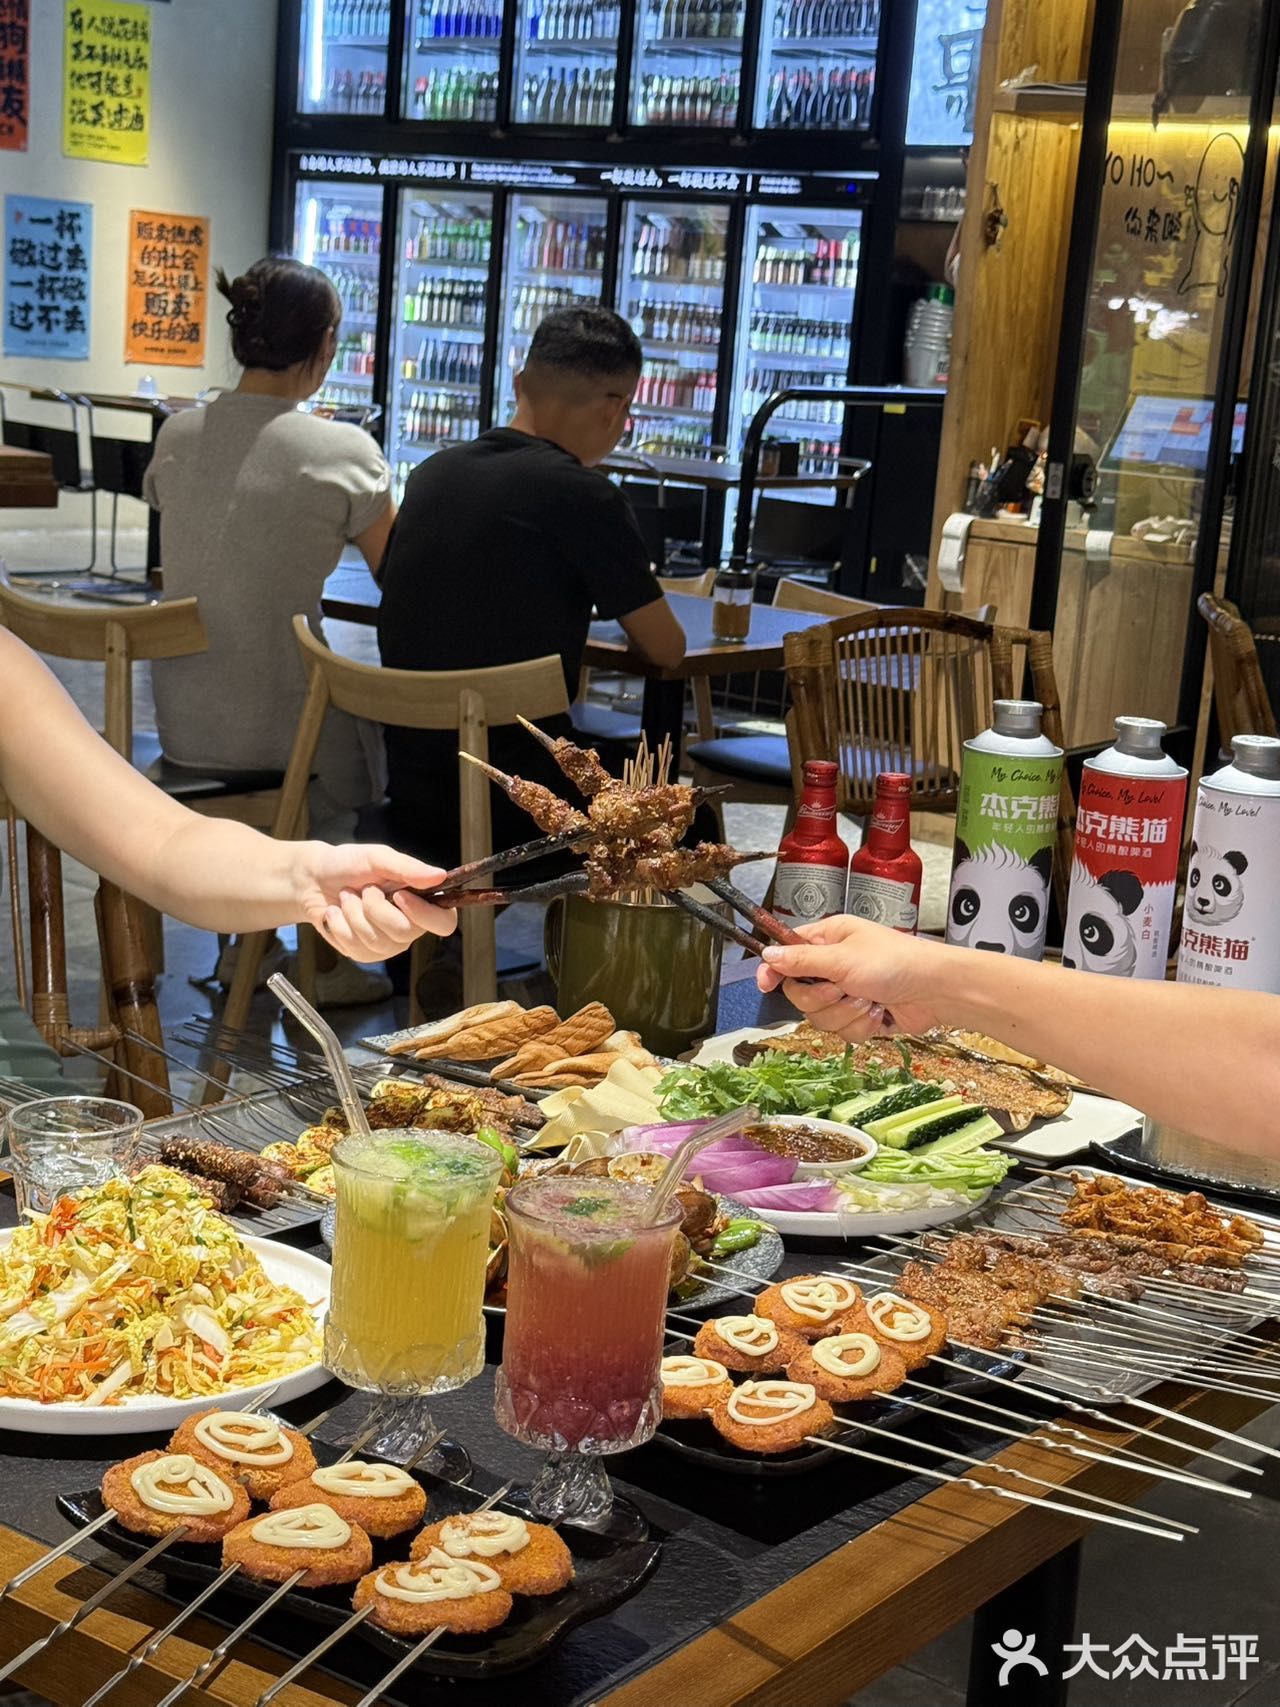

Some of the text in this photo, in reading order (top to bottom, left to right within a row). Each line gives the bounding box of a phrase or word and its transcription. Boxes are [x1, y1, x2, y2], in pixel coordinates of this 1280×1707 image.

[29, 210, 82, 241] 一杯
[137, 221, 204, 247] 贩卖焦虑
[10, 238, 87, 272] 敬过去
[141, 245, 198, 271] 的社会
[9, 273, 86, 303] 一杯敬
[9, 302, 86, 334] 过不去
[144, 292, 191, 321] 贩卖
[131, 319, 200, 343] 快乐的酒
[990, 766, 1006, 783] My
[1117, 788, 1135, 805] My
[1218, 801, 1232, 817] My
[1077, 836, 1152, 858] 轻人的精酿啤酒
[1142, 903, 1154, 940] 小麦白
[1182, 926, 1249, 961] 克熊猫
